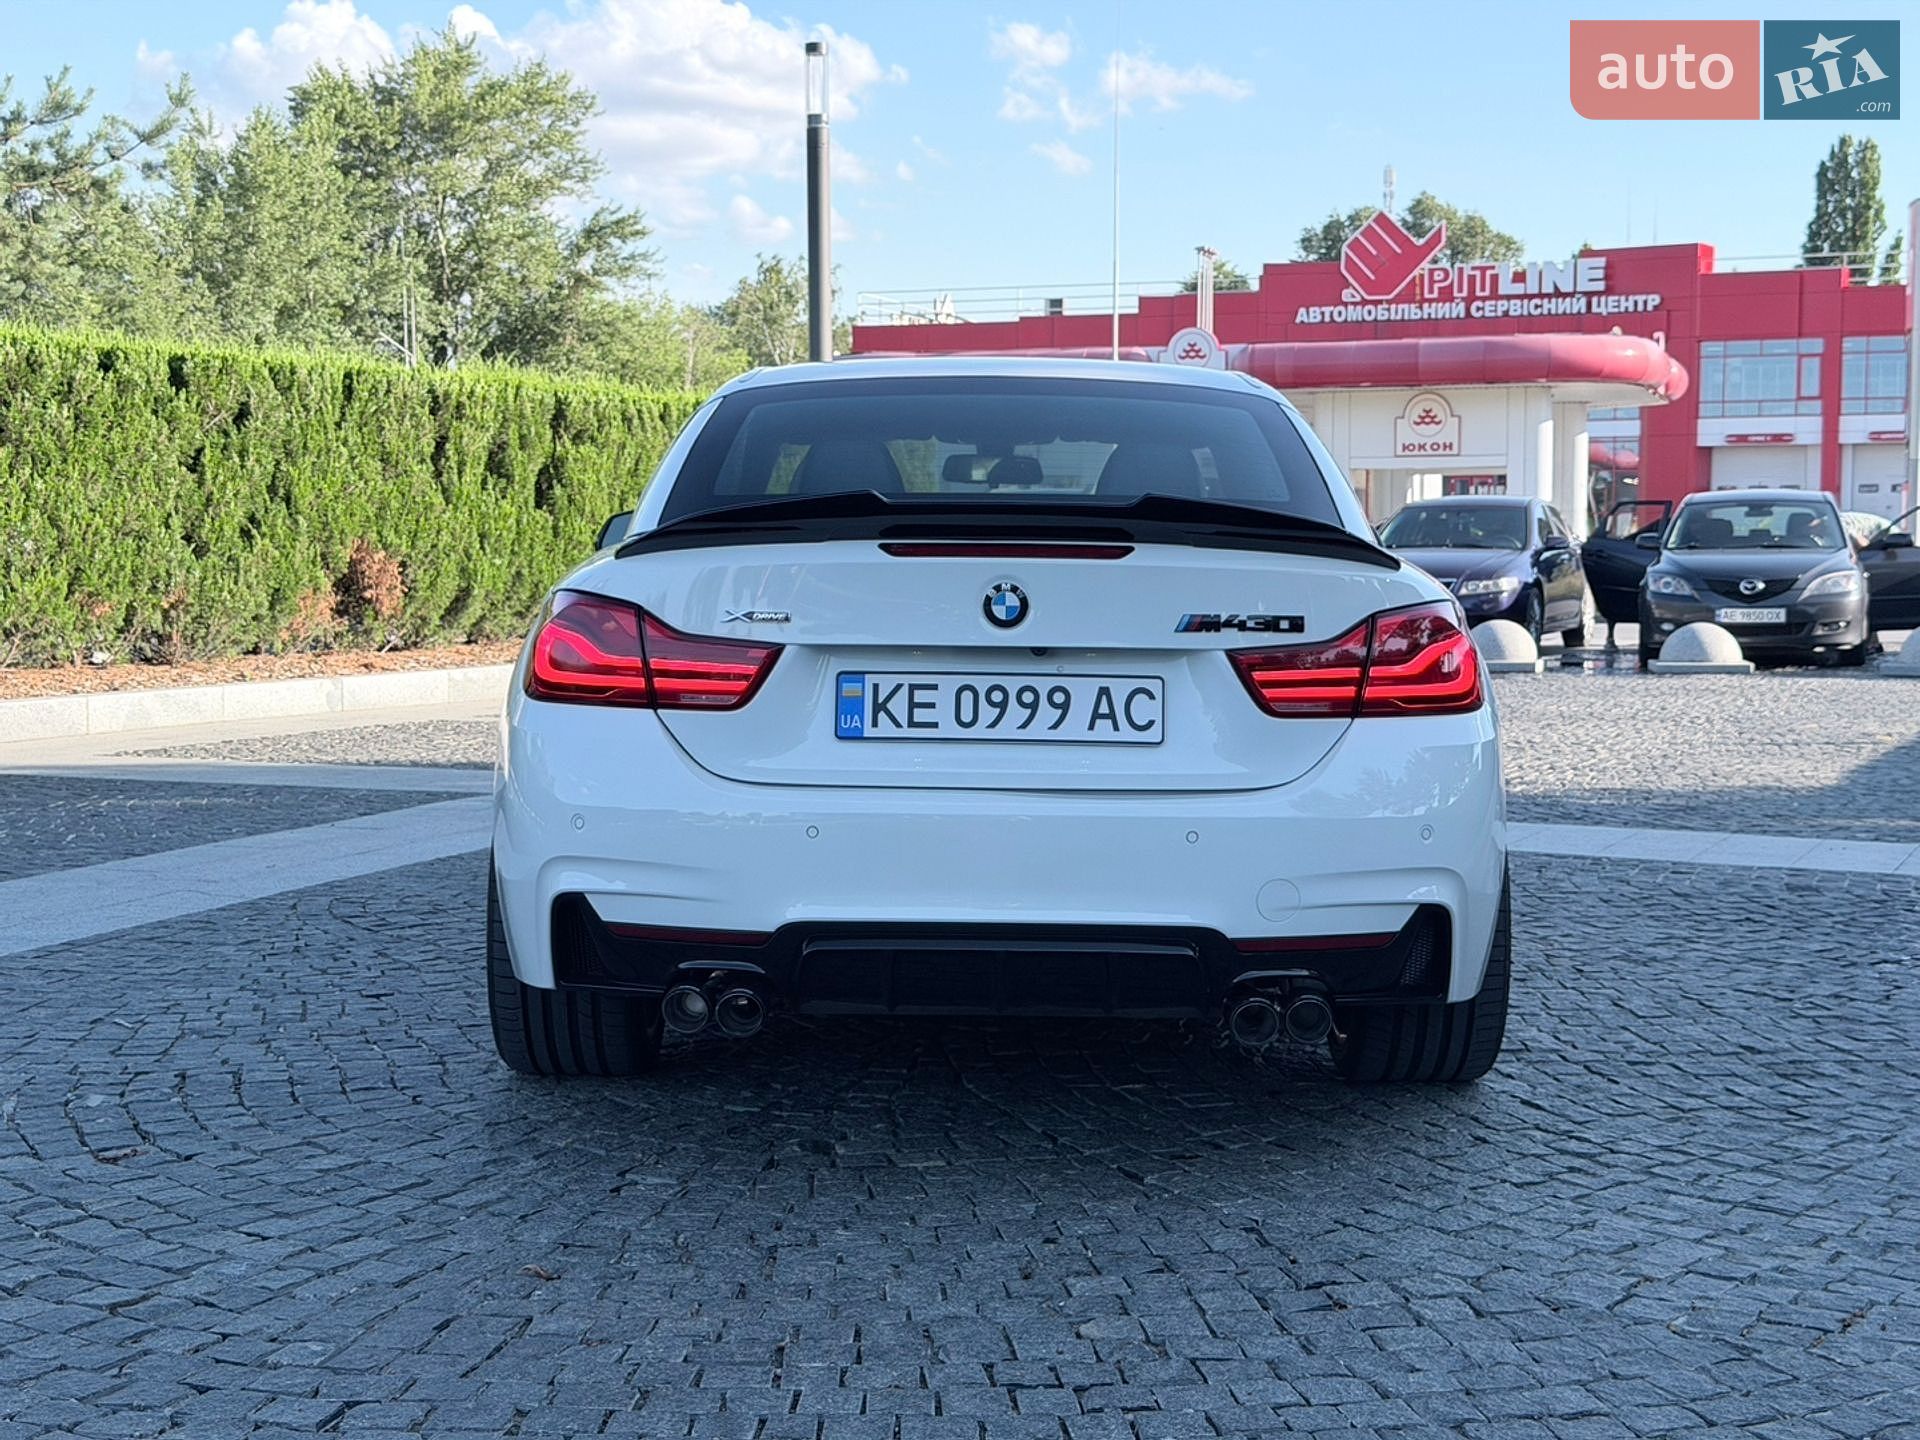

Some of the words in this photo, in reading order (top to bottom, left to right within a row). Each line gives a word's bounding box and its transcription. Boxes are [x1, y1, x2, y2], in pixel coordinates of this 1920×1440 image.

[1423, 256, 1607, 299] PITLINE
[1295, 299, 1466, 324] АВТОМОБІЛЬНИЙ
[1470, 294, 1586, 319] СЕРВІСНИЙ
[1591, 294, 1662, 317] ЦЕНТР
[1402, 441, 1454, 453] ЮКОН
[841, 715, 862, 729] UA
[871, 683, 939, 729] KE
[954, 683, 1071, 730] 0999
[1087, 686, 1157, 732] AC
